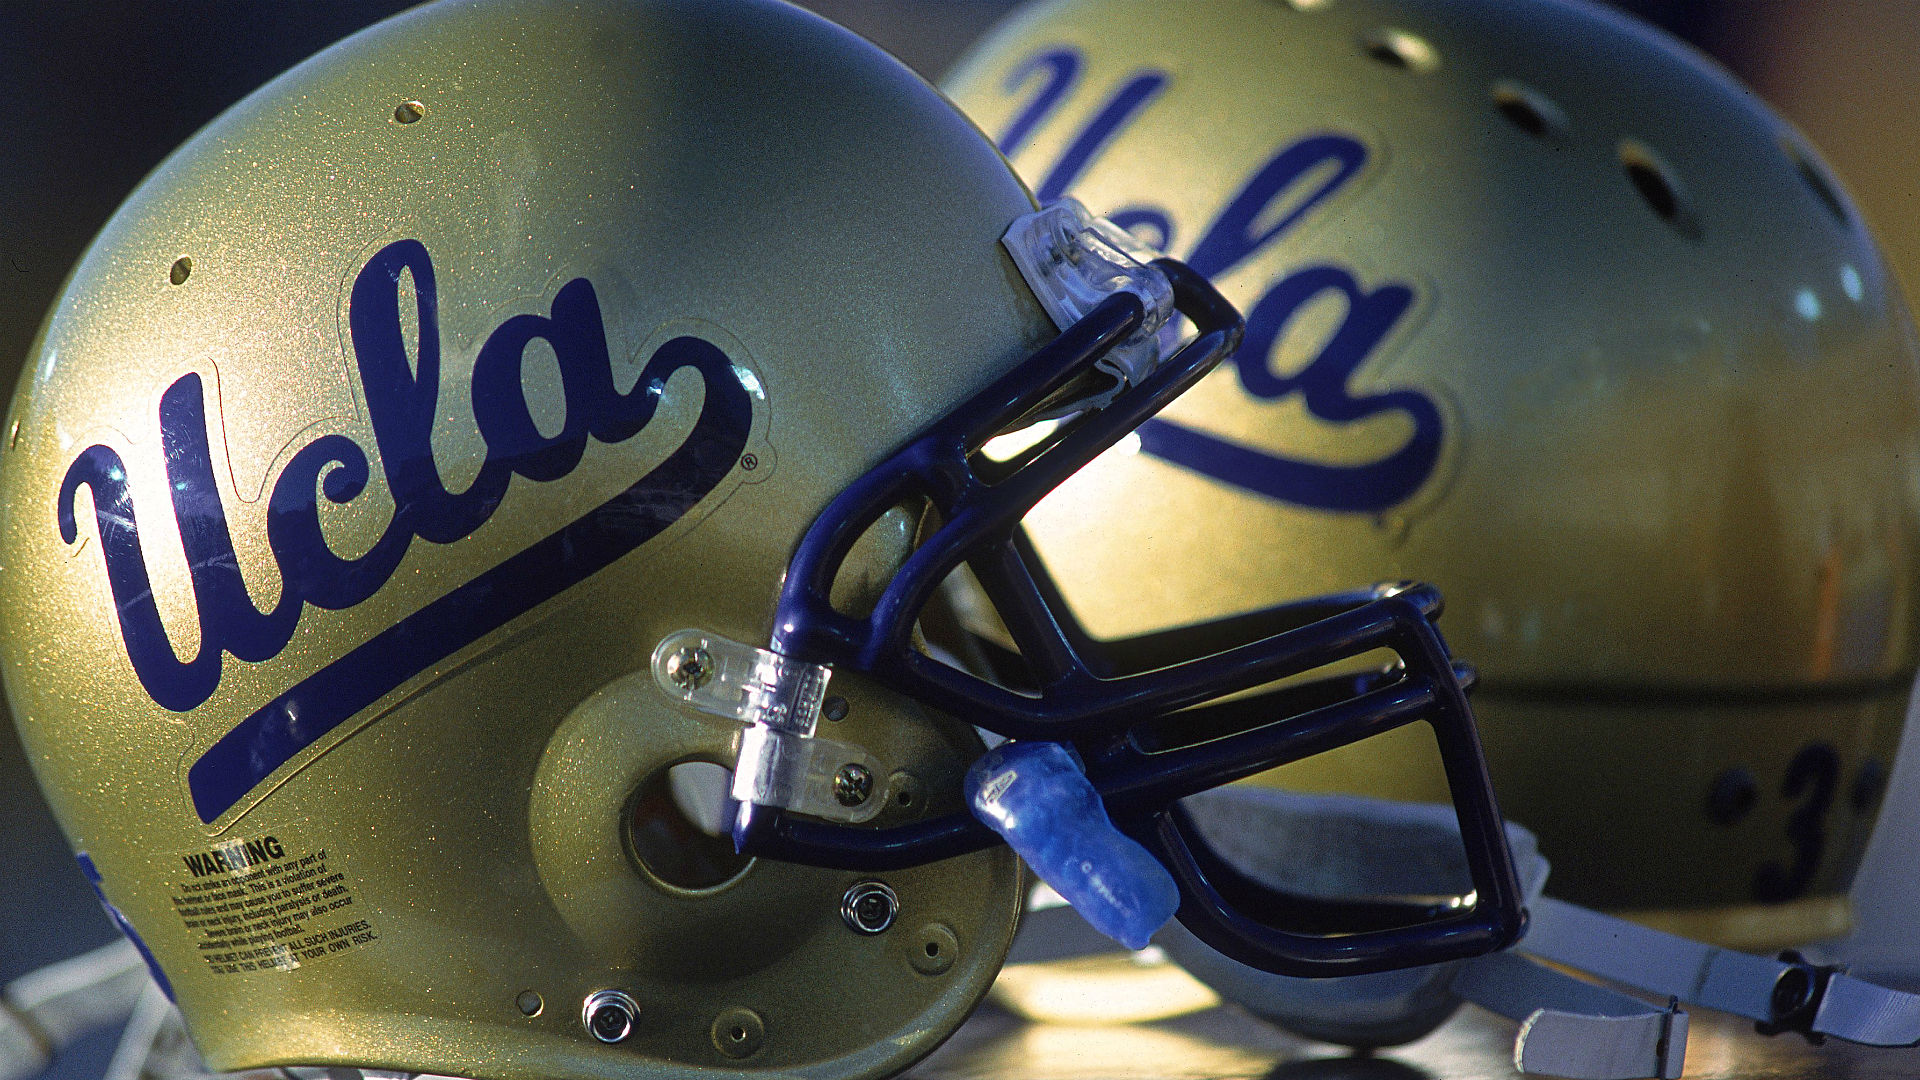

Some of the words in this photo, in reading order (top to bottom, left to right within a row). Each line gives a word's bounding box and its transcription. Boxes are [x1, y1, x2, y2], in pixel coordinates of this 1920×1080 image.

[182, 836, 285, 877] WARNING
[231, 869, 266, 886] opponent
[266, 864, 283, 876] with
[283, 861, 299, 871] any
[299, 853, 317, 868] part
[318, 848, 327, 860] of
[229, 902, 245, 911] may
[244, 896, 267, 907] cause
[266, 893, 282, 904] you
[281, 889, 291, 898] to
[291, 882, 315, 895] suffer
[316, 872, 344, 887] severe
[249, 882, 267, 893] This
[266, 880, 275, 889] is
[275, 879, 282, 887] a
[282, 868, 317, 884] violation
[317, 863, 327, 875] of
[243, 906, 277, 920] including
[276, 897, 311, 915] paralysis
[312, 893, 321, 903] or
[321, 884, 348, 899] death.
[270, 916, 292, 928] injury
[293, 910, 310, 920] may
[310, 905, 328, 916] also
[328, 896, 353, 911] occur
[239, 951, 254, 960] CAN
[288, 940, 305, 951] ALL
[304, 933, 329, 947] SUCH
[328, 920, 372, 940] INJURIES.
[248, 933, 275, 946] playing
[273, 924, 305, 939] football.
[301, 946, 327, 960] YOUR
[328, 939, 350, 953] OWN
[352, 931, 378, 945] RISK.
